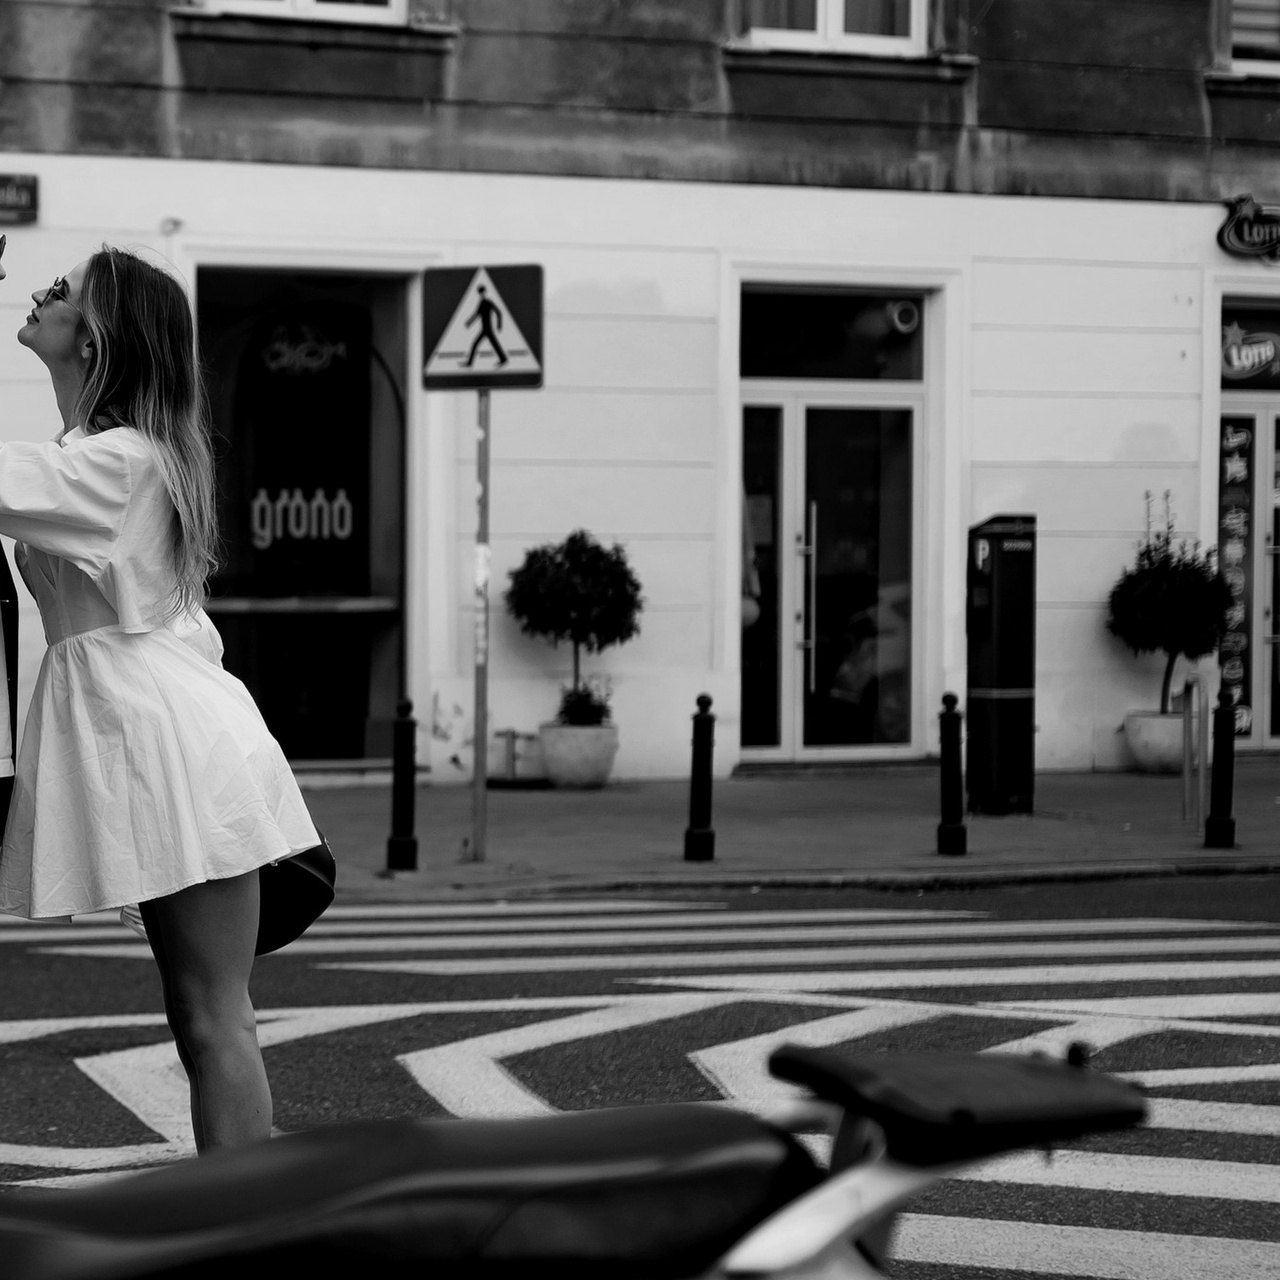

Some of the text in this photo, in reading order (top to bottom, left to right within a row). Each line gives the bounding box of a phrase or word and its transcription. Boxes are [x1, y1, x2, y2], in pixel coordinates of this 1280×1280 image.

[1242, 220, 1280, 243] LOTT
[1230, 339, 1276, 371] LOTTO
[251, 486, 353, 550] grono
